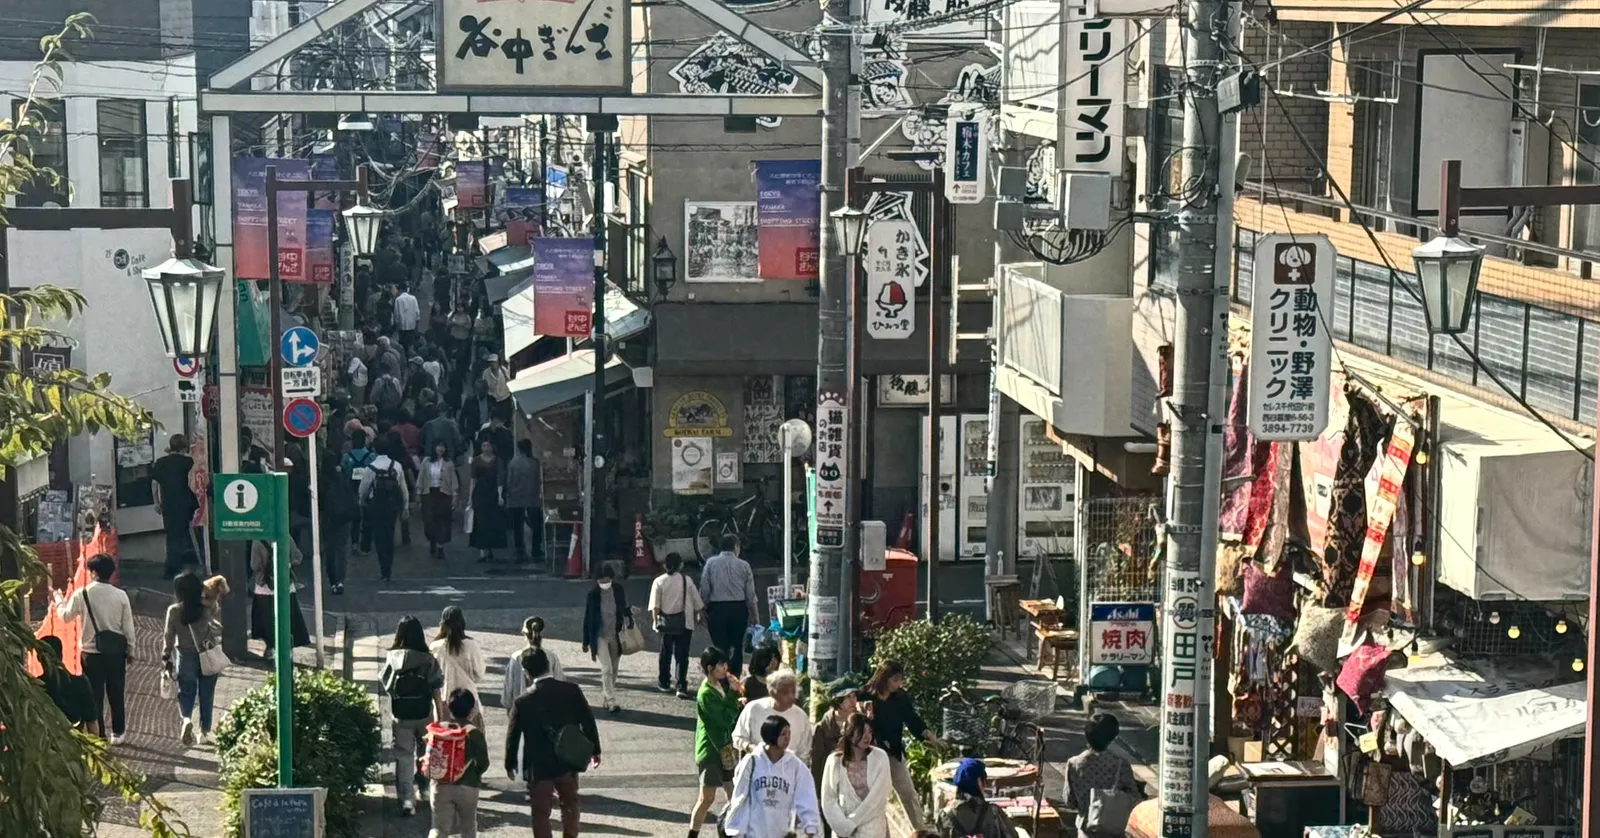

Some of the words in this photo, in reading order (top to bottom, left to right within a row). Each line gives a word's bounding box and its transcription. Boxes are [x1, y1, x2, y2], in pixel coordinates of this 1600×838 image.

[455, 0, 613, 75] 谷中ぎんざ
[895, 229, 911, 278] かき氷
[872, 319, 910, 331] ひみつ堂
[1266, 288, 1291, 398] クリニック
[1290, 288, 1317, 400] 動物・野澤
[284, 379, 316, 387] 一方通行
[889, 374, 931, 396] 後藤の
[818, 419, 827, 453] のお店
[828, 410, 843, 459] 猫雑貨
[1262, 424, 1314, 433] 3894-7739
[635, 521, 645, 557] 立入禁止
[1107, 608, 1139, 619] Asahi
[1102, 629, 1146, 649] 焼肉
[1101, 653, 1146, 661] サラリーマン
[1171, 633, 1197, 688] 田戸
[754, 776, 790, 795] ORIGIN
[1166, 825, 1191, 834] 3-13
